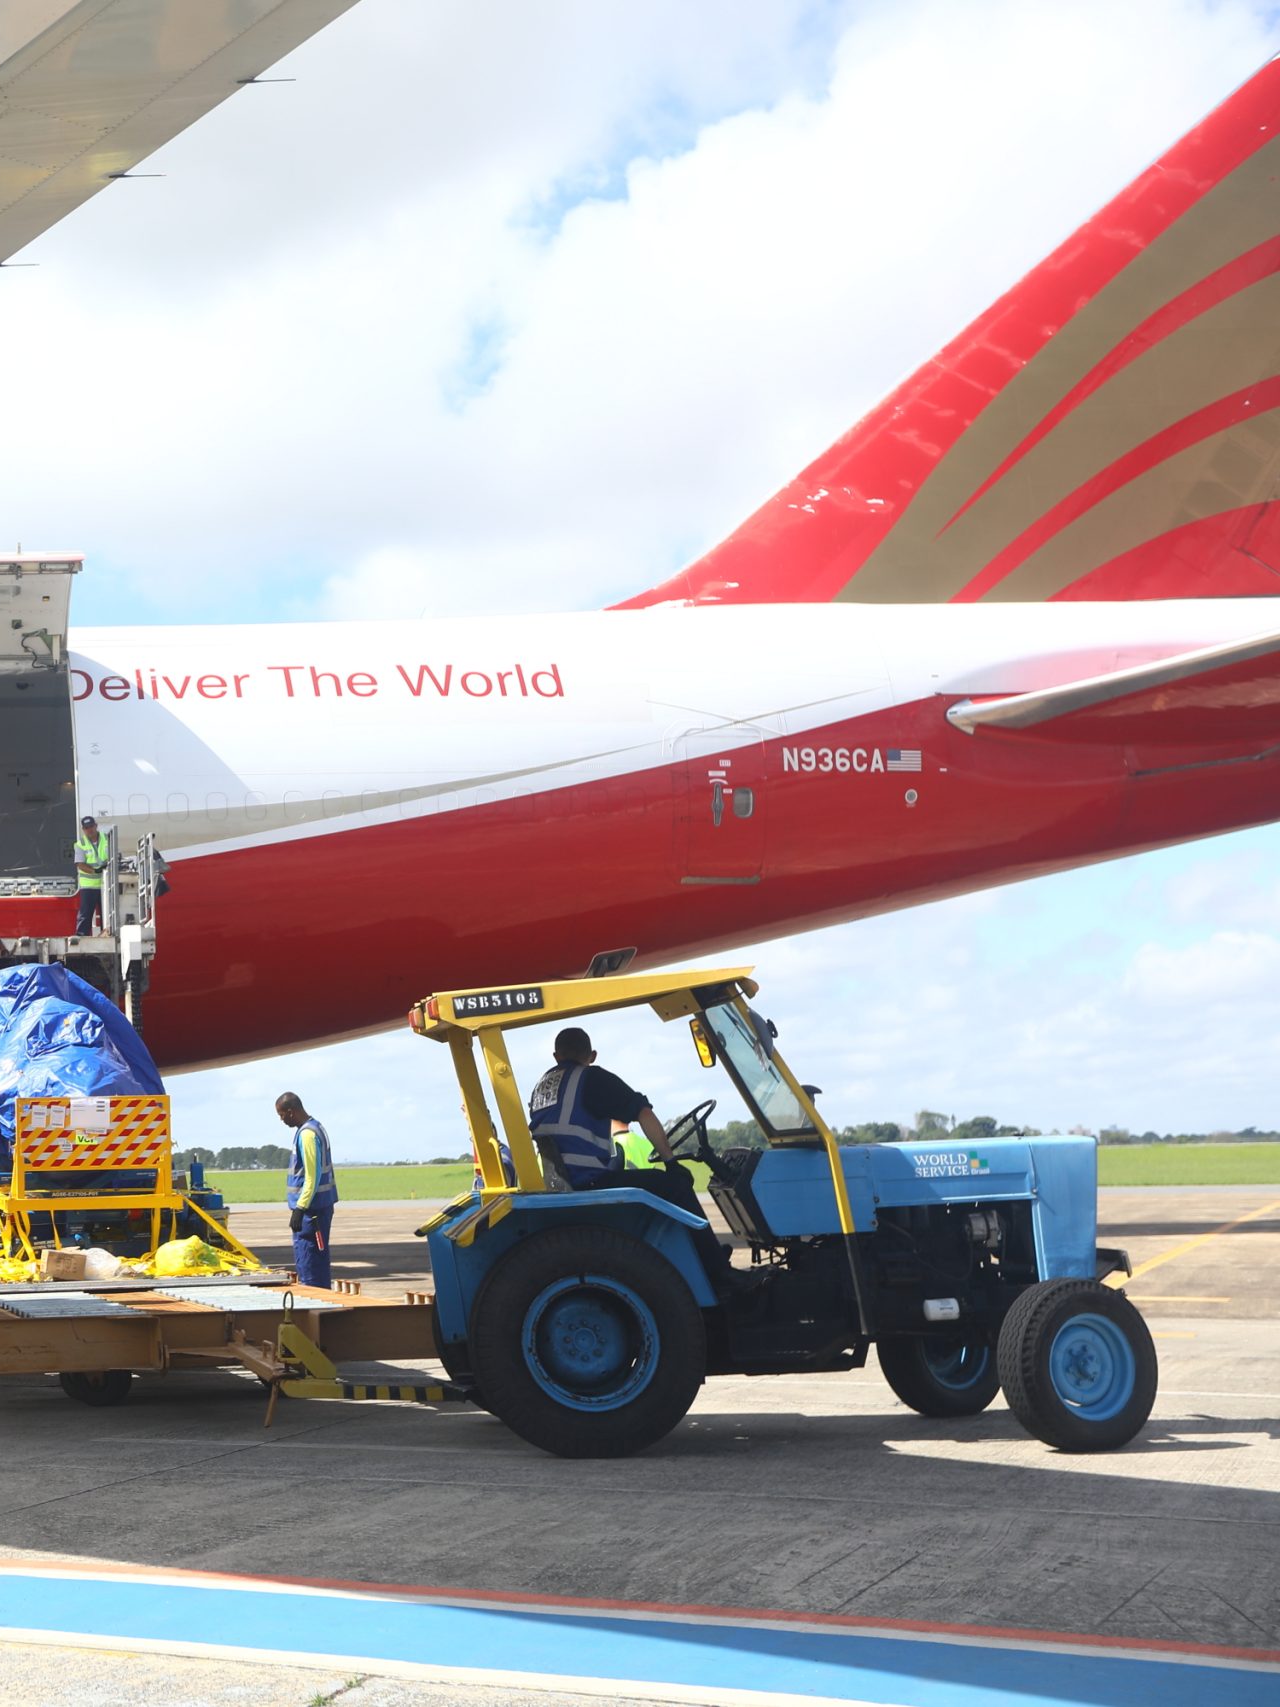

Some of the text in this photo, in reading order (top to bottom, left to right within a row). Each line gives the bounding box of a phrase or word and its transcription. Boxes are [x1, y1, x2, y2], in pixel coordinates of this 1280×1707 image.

[267, 665, 379, 698] The
[396, 663, 566, 698] World
[782, 747, 885, 773] N936CA
[453, 991, 539, 1011] WSB5108
[913, 1153, 968, 1166] WORLD
[915, 1165, 970, 1178] SERVICE
